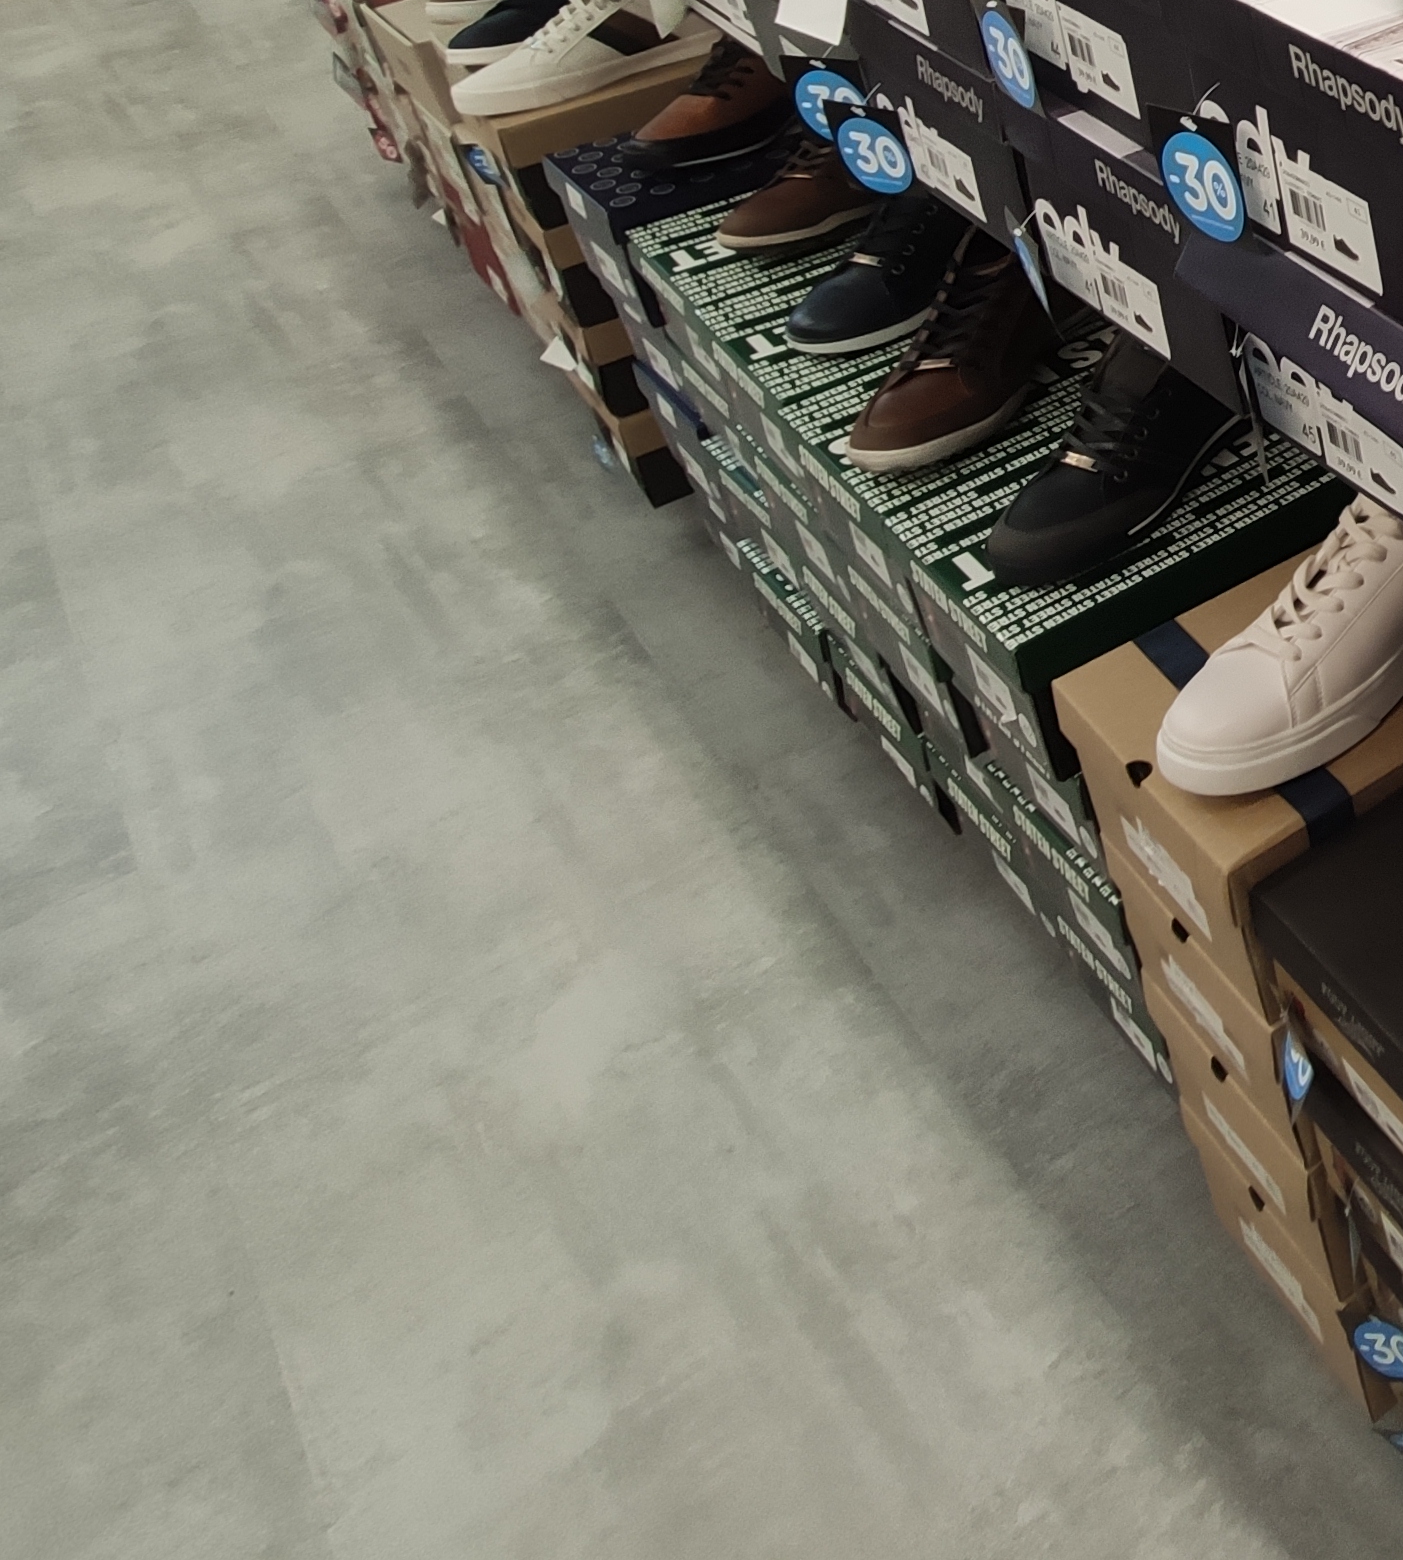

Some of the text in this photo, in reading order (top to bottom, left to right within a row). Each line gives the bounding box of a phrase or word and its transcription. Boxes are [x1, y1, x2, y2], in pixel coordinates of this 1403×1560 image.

[915, 54, 985, 123] Rhapsody
[1094, 159, 1181, 244] Rhapsody
[1262, 197, 1277, 218] 41
[1302, 423, 1316, 443] 45
